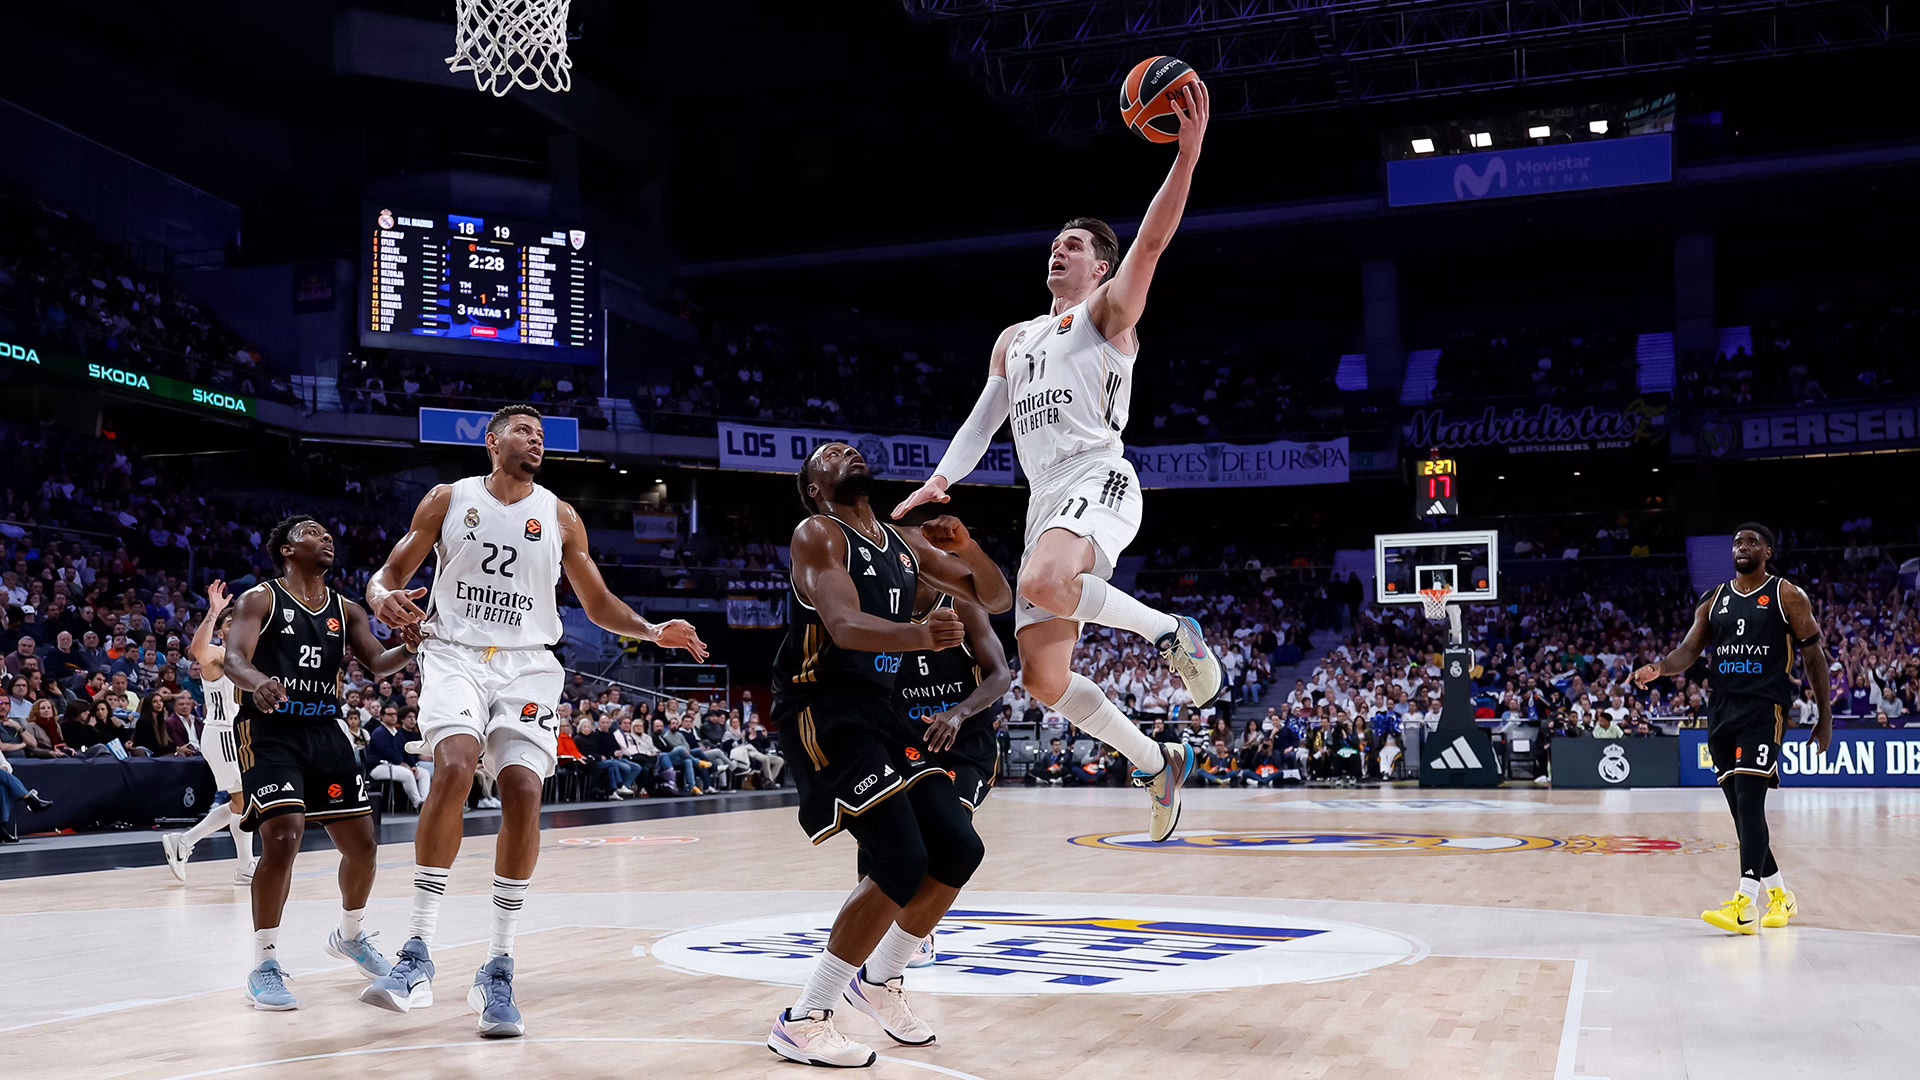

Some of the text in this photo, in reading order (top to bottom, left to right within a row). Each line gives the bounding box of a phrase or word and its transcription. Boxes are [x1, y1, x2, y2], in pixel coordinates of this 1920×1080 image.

[1516, 154, 1590, 175] Movistar
[1518, 174, 1590, 188] ARENA
[458, 222, 474, 235] 18
[494, 226, 510, 238] 19
[469, 254, 504, 271] 2:28
[459, 281, 471, 289] TM
[480, 294, 486, 304] 1
[458, 304, 510, 319] 3 FALTAS 1
[1025, 350, 1046, 384] 11
[1017, 407, 1060, 437] FLY BETTER
[1405, 404, 1640, 448] Madridistas
[1742, 408, 1920, 450] BERSER
[726, 430, 776, 457] LOS
[893, 443, 938, 468] DEL
[1140, 453, 1207, 473] REYES
[1223, 452, 1252, 472] DE
[1424, 460, 1452, 475] 2:27
[1429, 475, 1451, 499] 17
[1060, 496, 1088, 520] 11
[481, 542, 518, 578] 22
[456, 580, 534, 611] Emirates
[889, 588, 901, 614] 17
[466, 602, 523, 626] FLY BETTER
[1736, 618, 1745, 636] 3
[298, 645, 322, 668] 25
[917, 655, 929, 676] 5
[1718, 659, 1762, 674] dnata
[1756, 744, 1769, 766] 3
[1782, 741, 1880, 775] SOLAN
